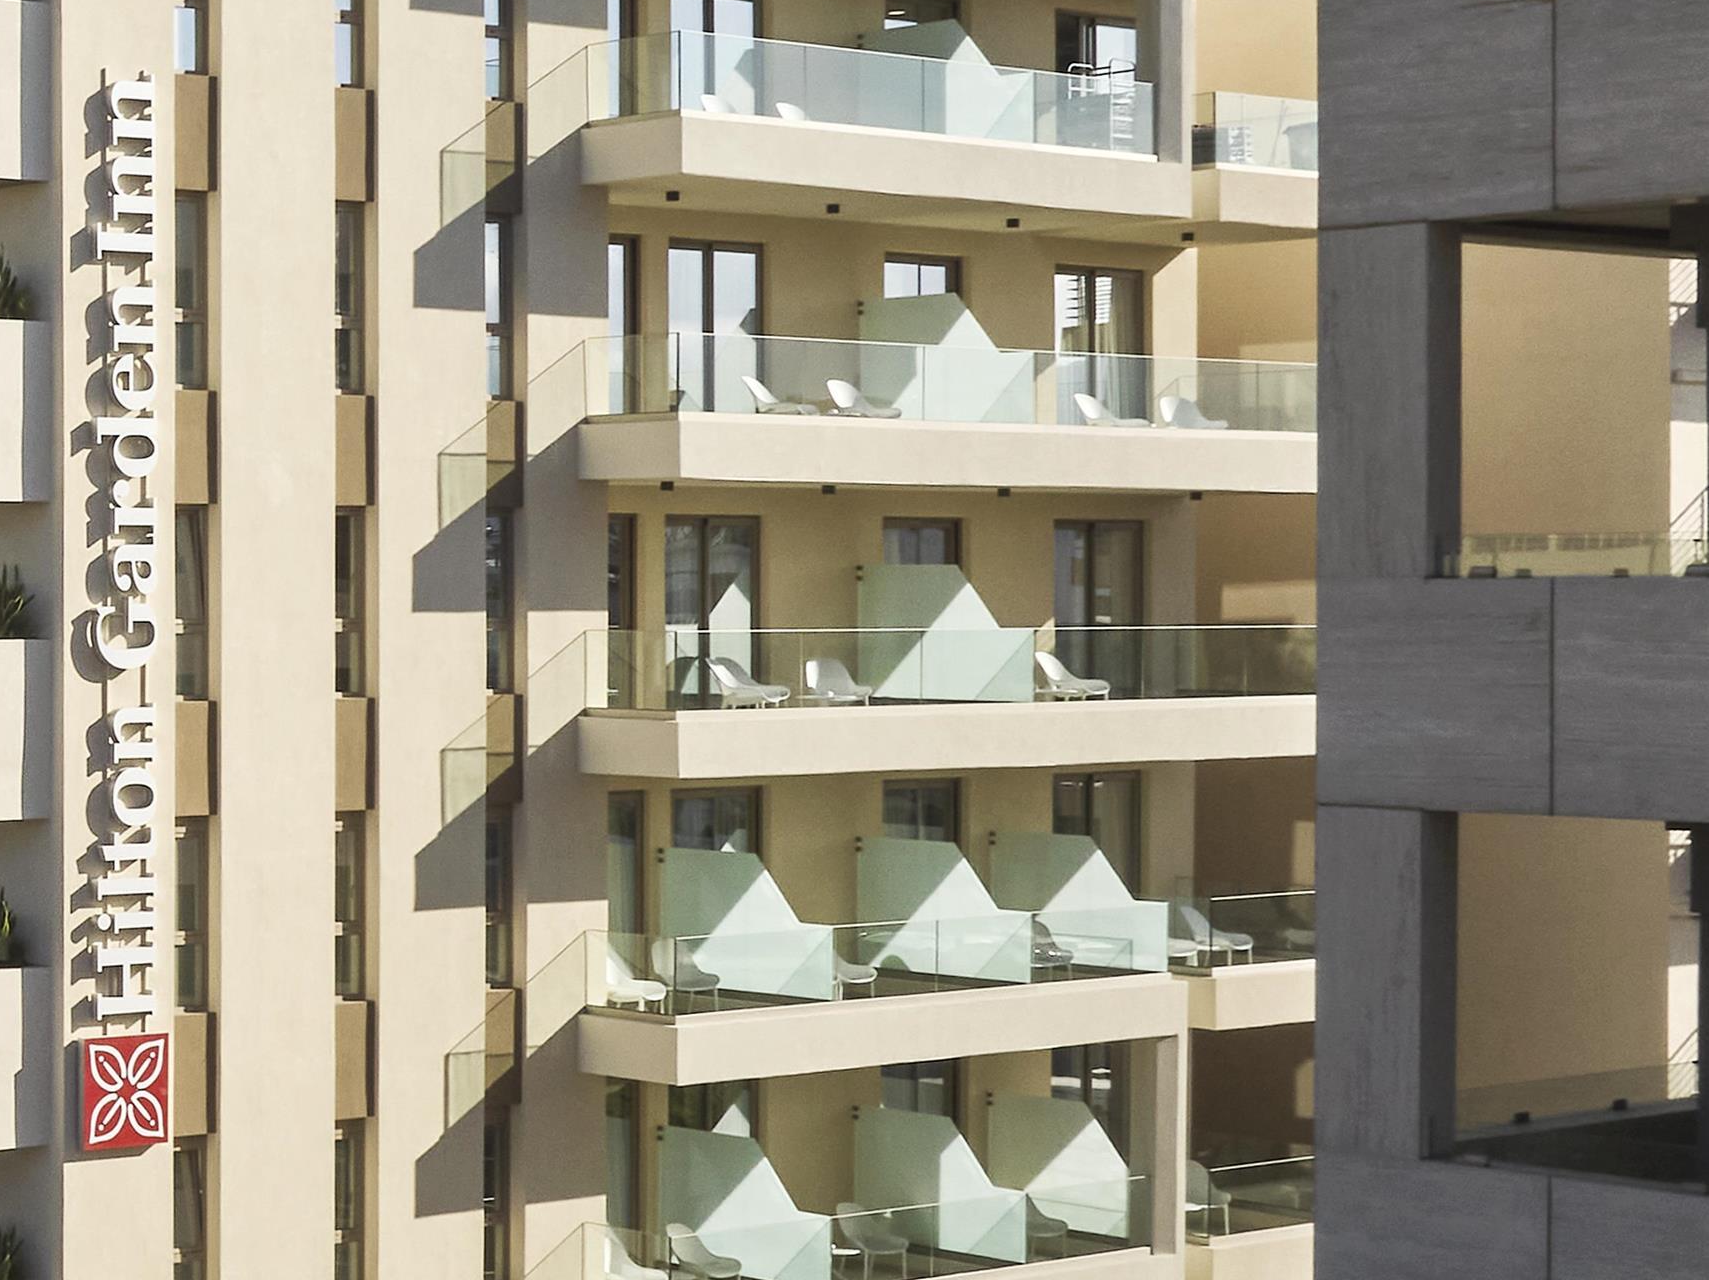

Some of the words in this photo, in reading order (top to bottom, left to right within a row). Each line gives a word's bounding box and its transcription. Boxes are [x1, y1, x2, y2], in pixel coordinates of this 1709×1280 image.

[96, 74, 155, 261] Inn
[96, 280, 158, 670] Garden
[96, 703, 155, 1022] Hilton
